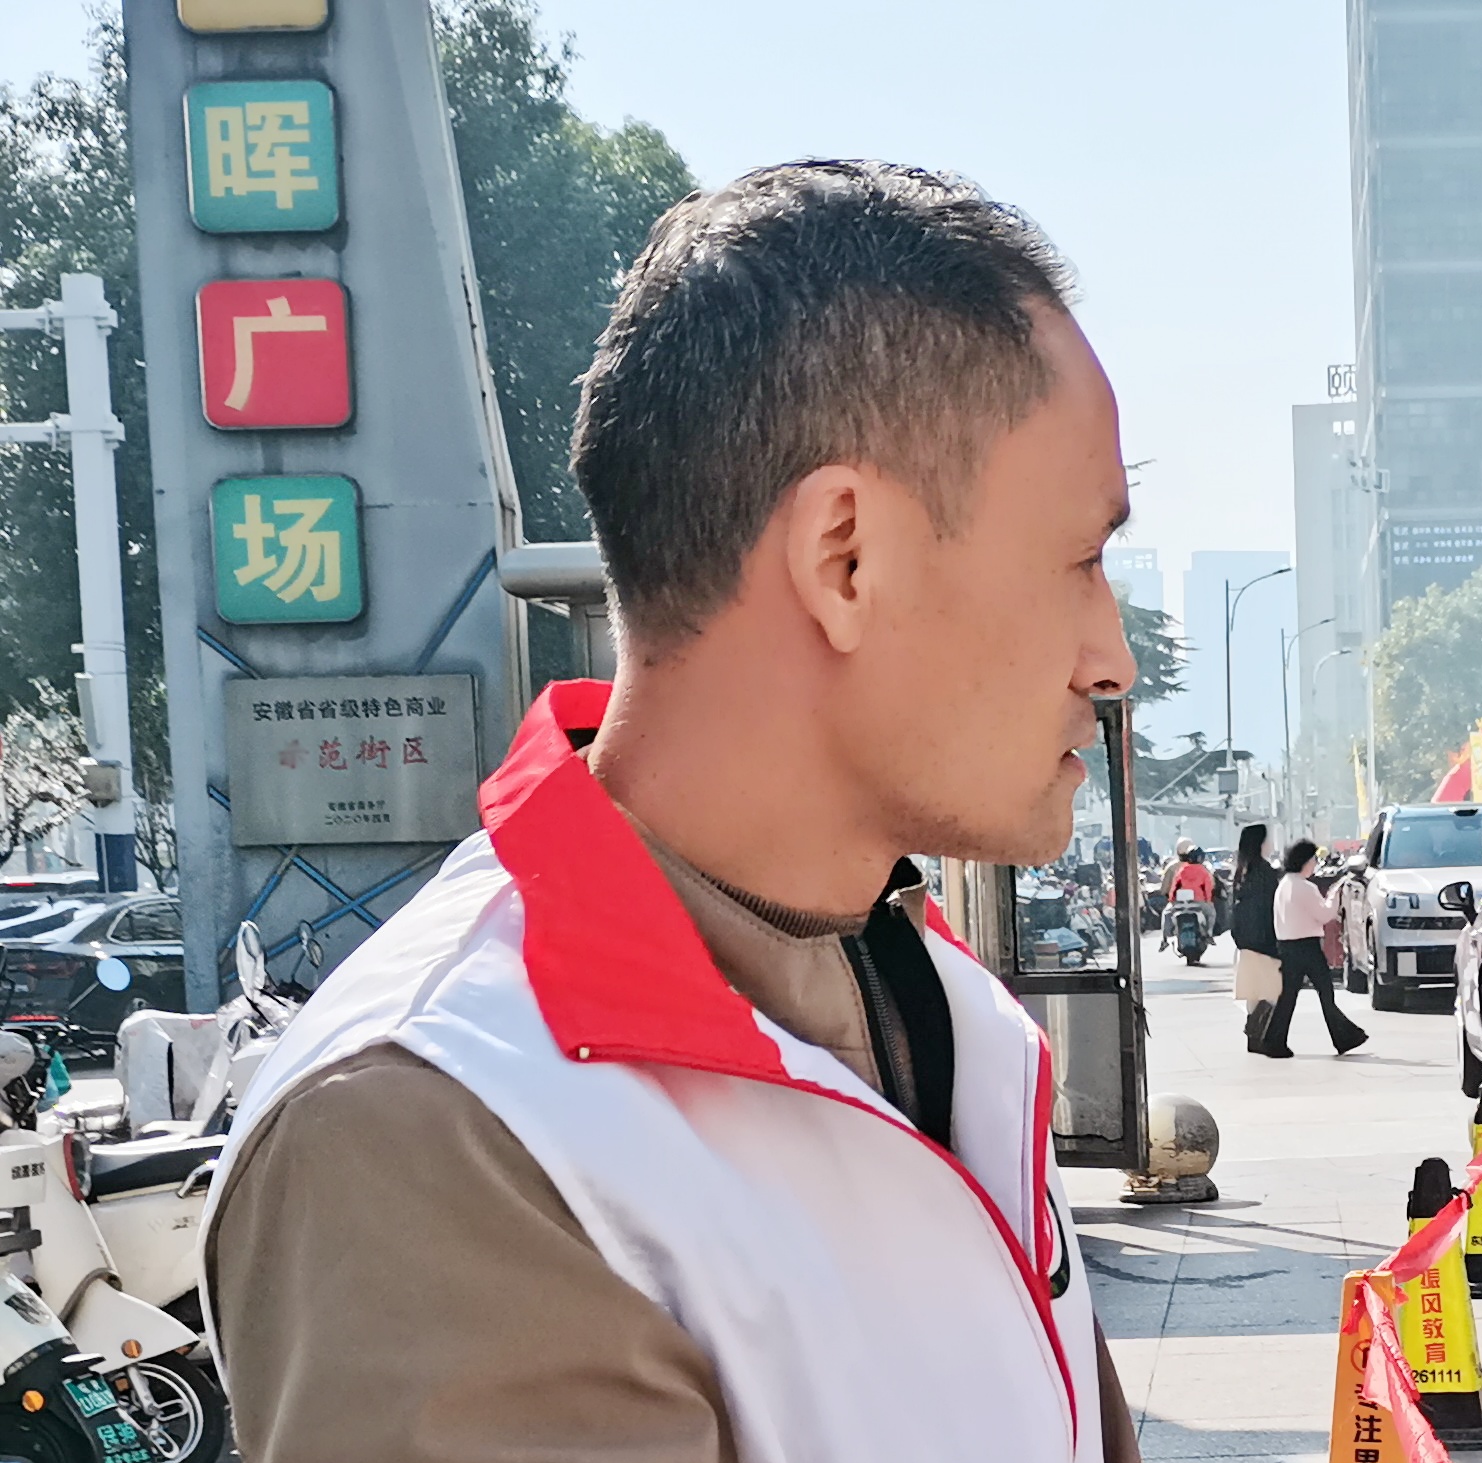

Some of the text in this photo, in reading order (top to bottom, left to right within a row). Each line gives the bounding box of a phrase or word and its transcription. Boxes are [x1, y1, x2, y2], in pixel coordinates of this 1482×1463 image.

[205, 101, 343, 603] 晖广场
[252, 696, 447, 721] 安徽省省级特色商业
